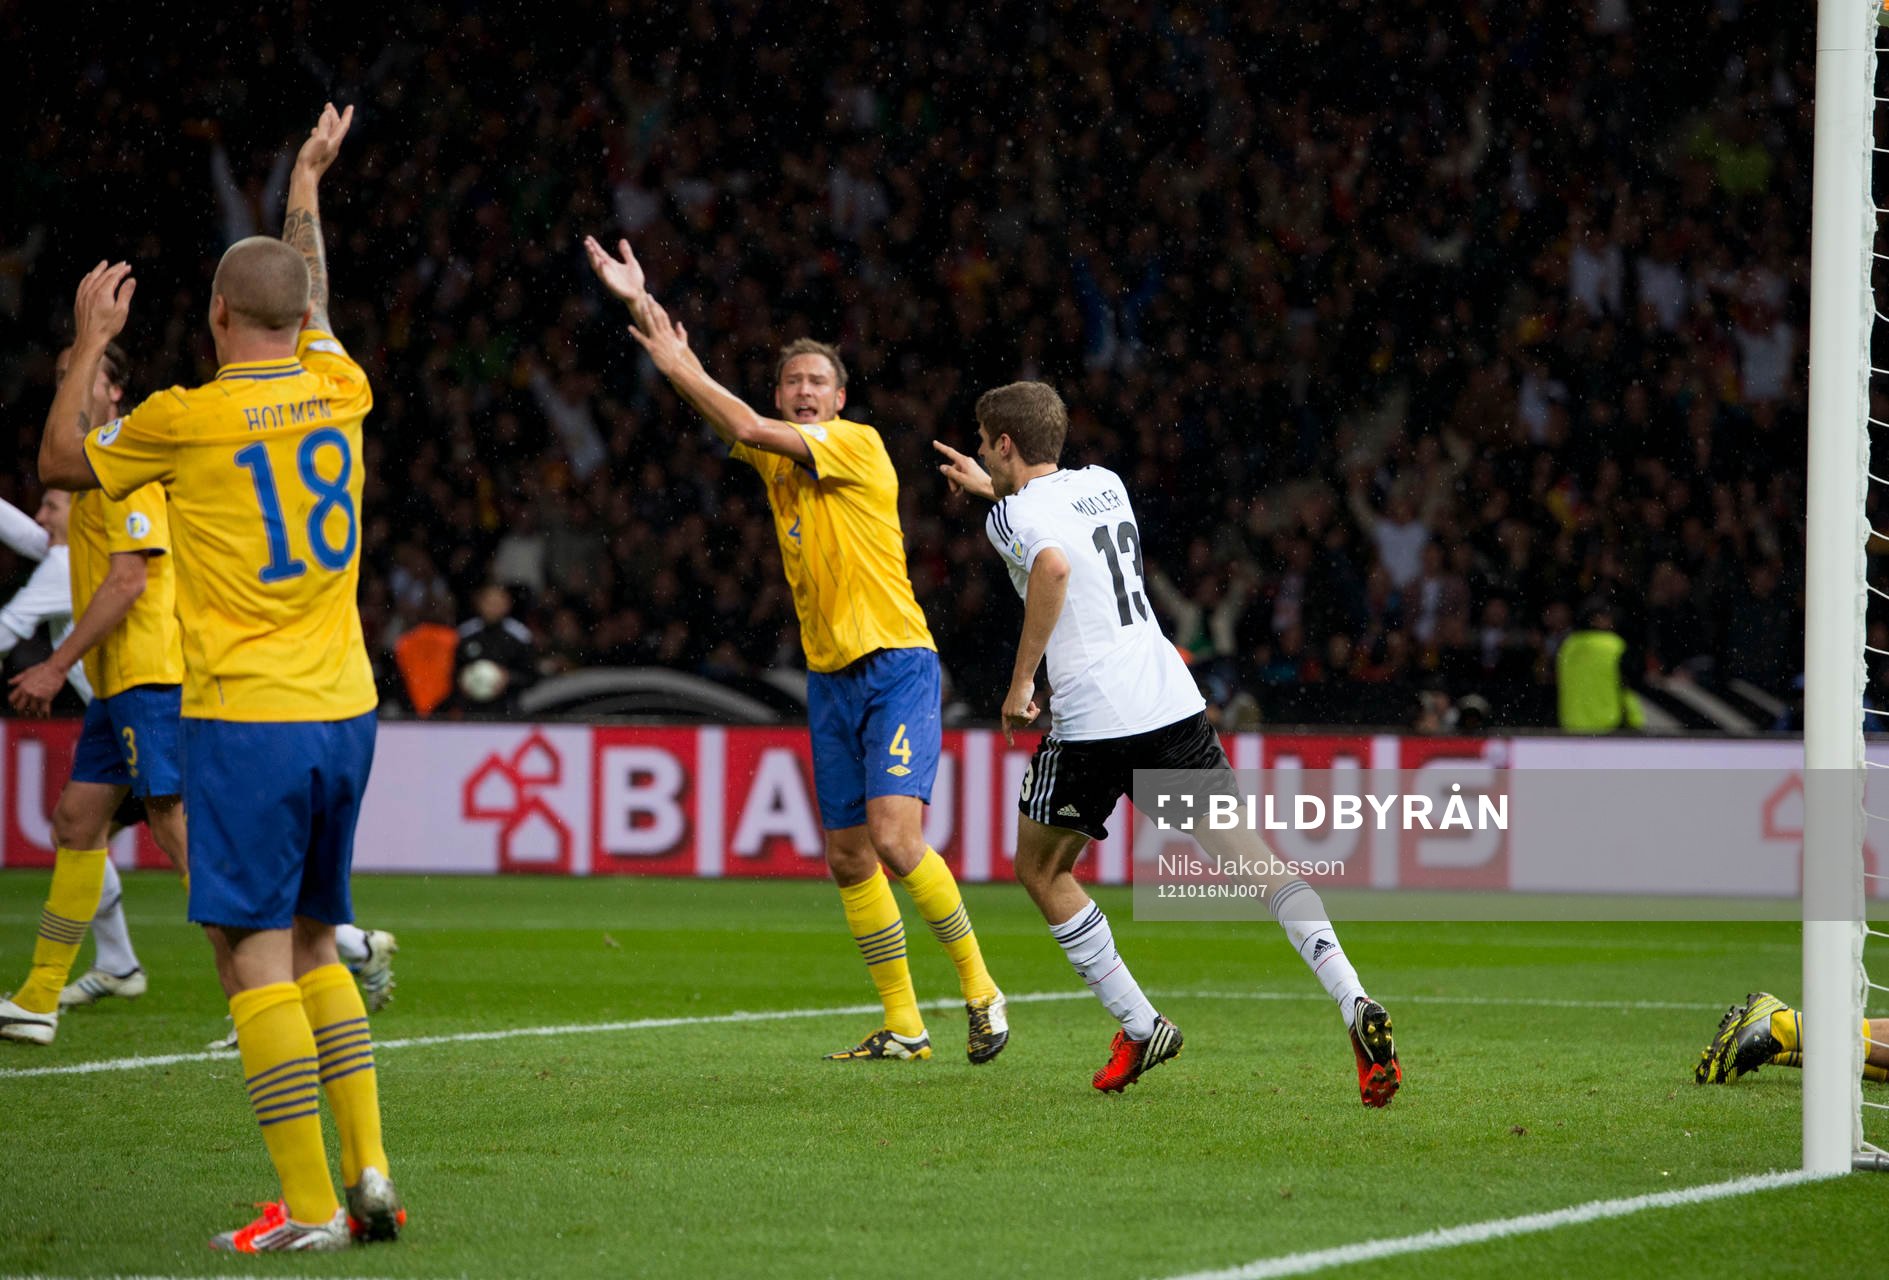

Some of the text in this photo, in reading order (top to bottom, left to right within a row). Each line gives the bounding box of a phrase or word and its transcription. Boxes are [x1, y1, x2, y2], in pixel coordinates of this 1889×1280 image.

[233, 426, 357, 584] 18
[1091, 521, 1149, 627] 13
[122, 726, 138, 766] 3
[889, 723, 912, 765] 4
